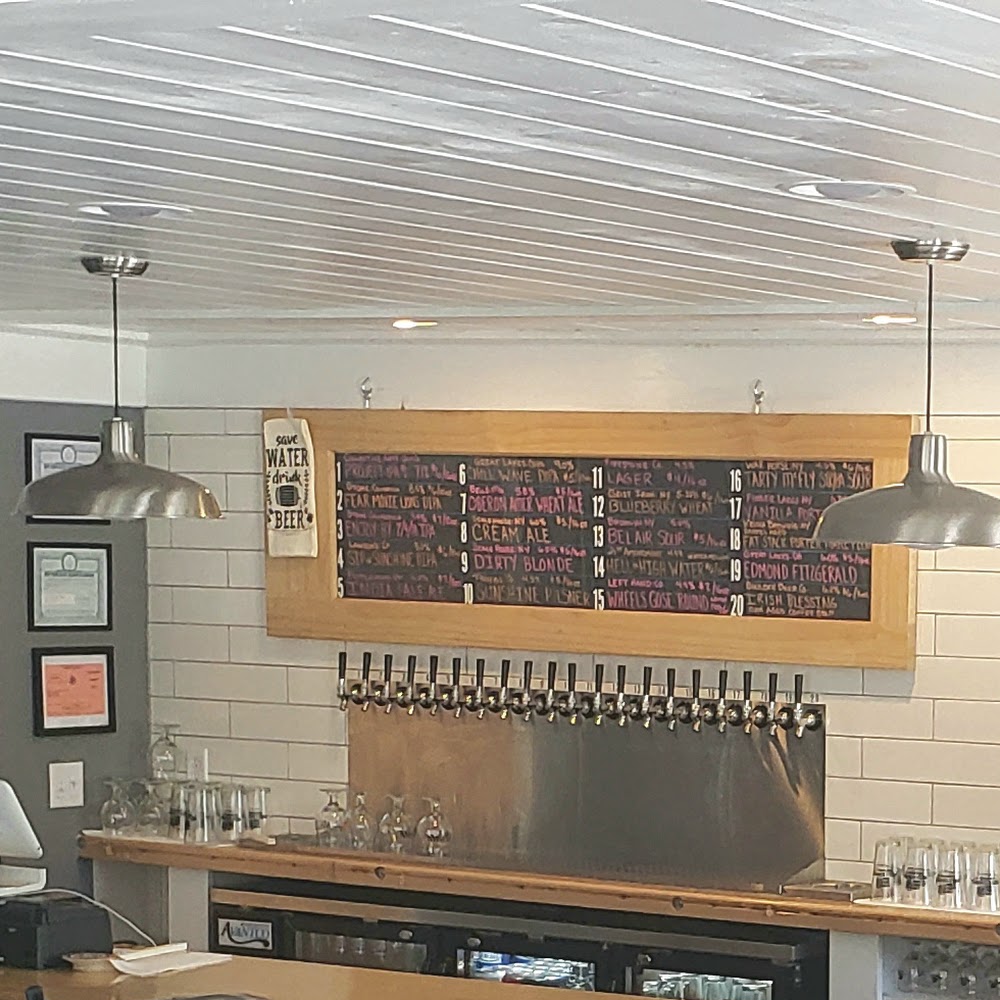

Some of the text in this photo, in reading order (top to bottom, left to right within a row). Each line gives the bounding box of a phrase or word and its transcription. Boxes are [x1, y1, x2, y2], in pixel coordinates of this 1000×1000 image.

[276, 434, 299, 446] save
[266, 447, 310, 468] WATER
[272, 469, 303, 487] drink
[336, 461, 342, 482] 1
[458, 462, 467, 486] 6
[498, 468, 532, 483] WAVE
[591, 466, 604, 490] 11
[606, 471, 653, 486] LAGER
[729, 468, 742, 493] 16
[743, 470, 778, 489] TARTY
[336, 489, 344, 511] 2
[459, 492, 467, 515] 7
[536, 496, 565, 514] WHEAT
[567, 496, 585, 515] ALE
[591, 495, 605, 518] 12
[608, 499, 714, 515] BLUEBERRY WHEAT
[729, 496, 743, 521] 17
[274, 509, 305, 529] BEER
[336, 518, 344, 540] 3
[460, 521, 468, 544] 8
[471, 523, 552, 544] CREAM ALE
[592, 525, 605, 548] 13
[634, 529, 653, 545] AIR
[657, 528, 686, 546] SOUR
[729, 527, 741, 551] 18
[742, 534, 762, 551] FAT
[337, 547, 345, 570] 4
[461, 550, 469, 574] 9
[473, 553, 575, 574] DIRTY BLONDE
[592, 555, 606, 579] 14
[669, 560, 704, 580] WATER
[730, 558, 742, 582] 19
[791, 564, 859, 584] FITZGERALD
[337, 576, 345, 599] 5
[462, 582, 474, 604] 10
[607, 578, 630, 588] LEFT
[544, 586, 591, 607] PILSNER
[592, 588, 605, 611] 15
[607, 588, 648, 609] WHEELS
[729, 594, 744, 617] 20
[745, 593, 783, 607] IRISH
[786, 593, 838, 610] BLESSING
